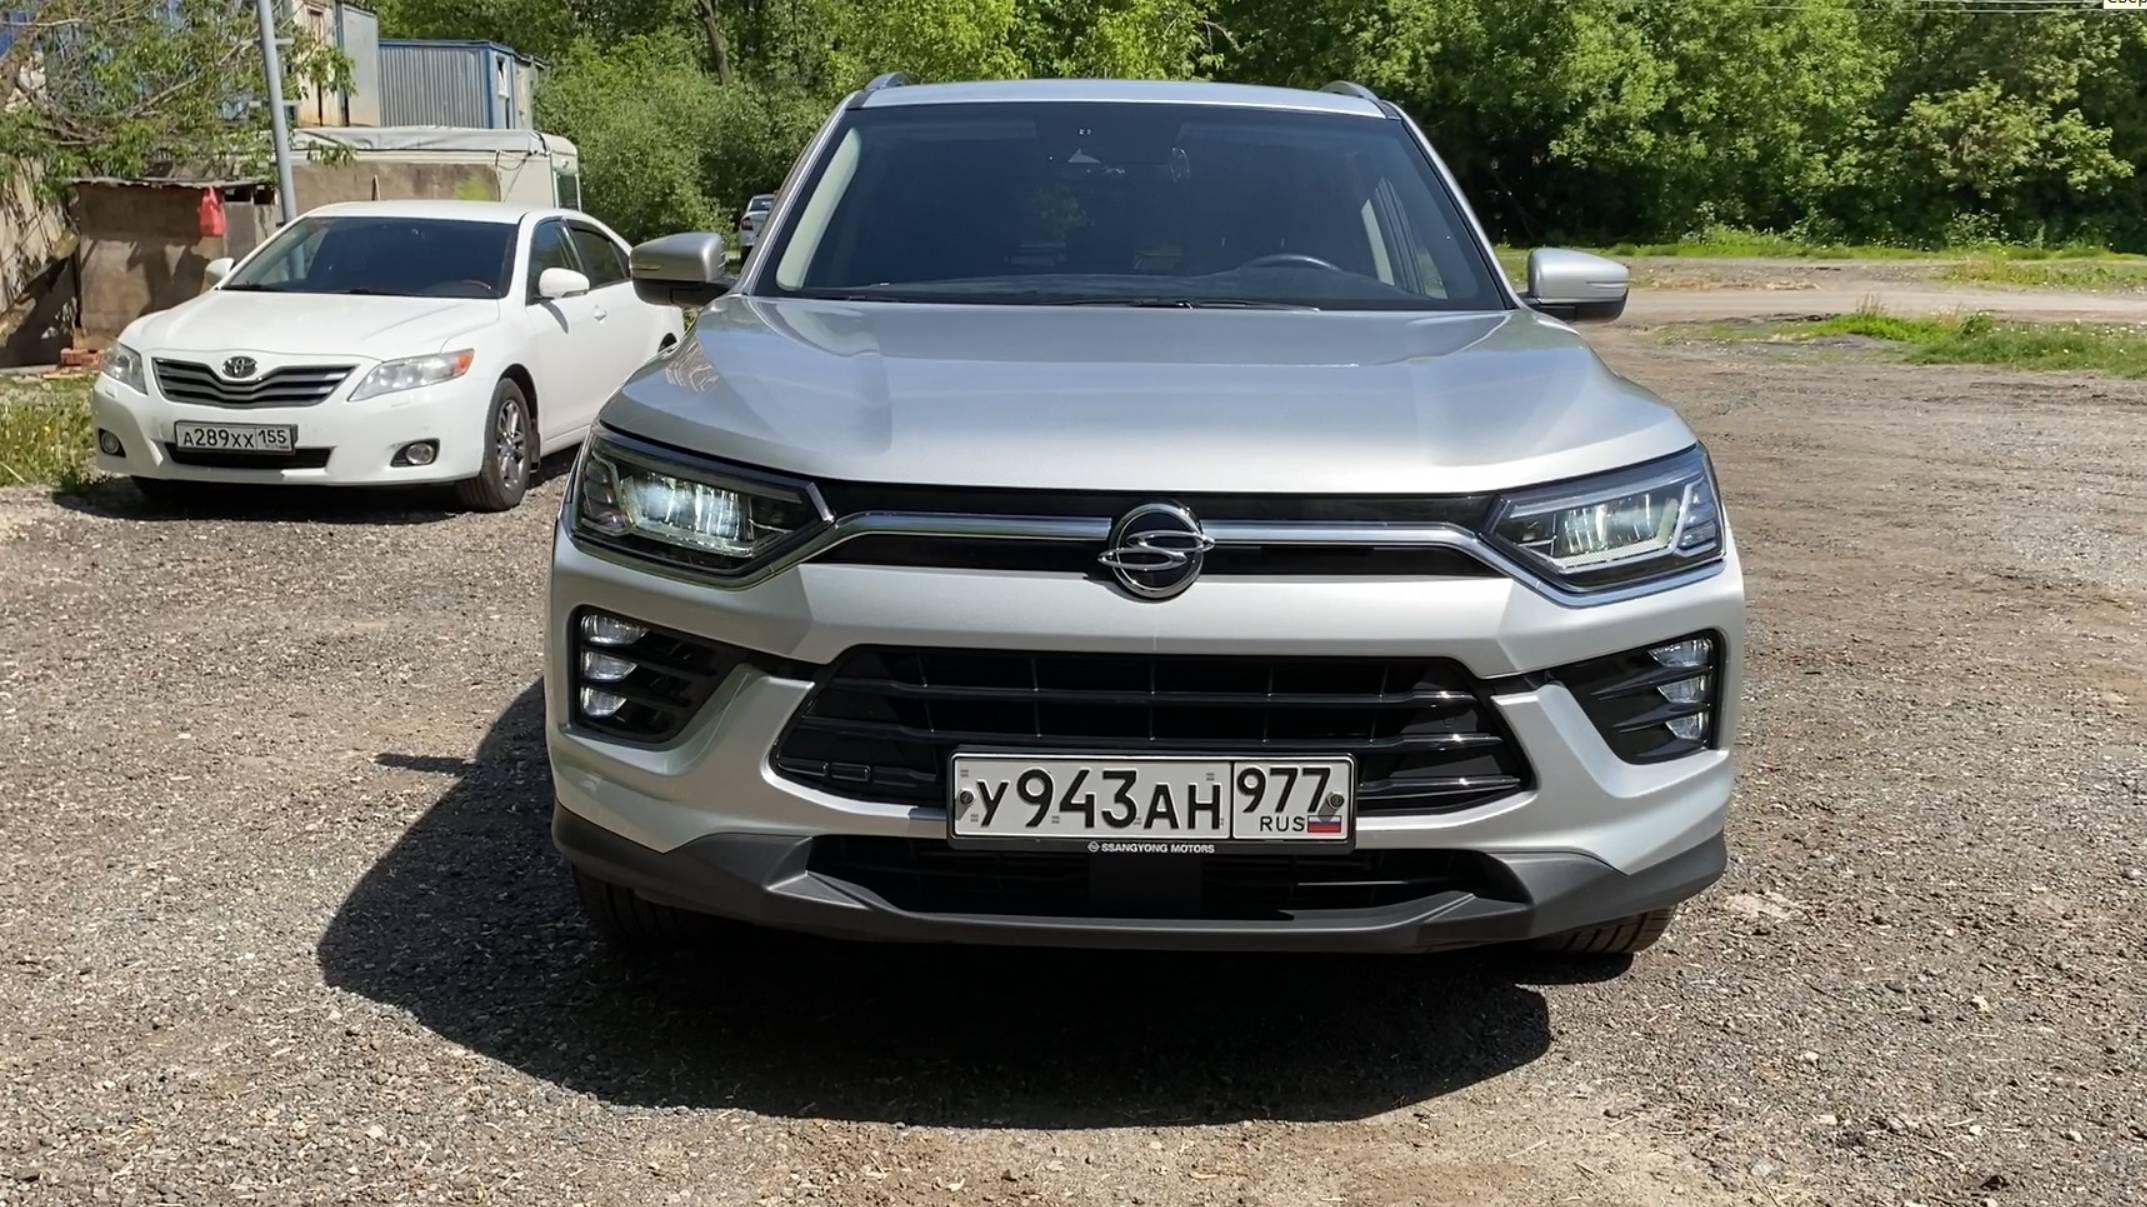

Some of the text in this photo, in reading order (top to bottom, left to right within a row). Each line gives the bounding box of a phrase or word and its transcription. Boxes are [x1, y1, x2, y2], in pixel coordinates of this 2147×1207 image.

[258, 429, 288, 444] 155
[1237, 766, 1332, 814] 977
[1259, 815, 1306, 833] RUS
[1101, 842, 1216, 855] SSANGYONG MOTORS
